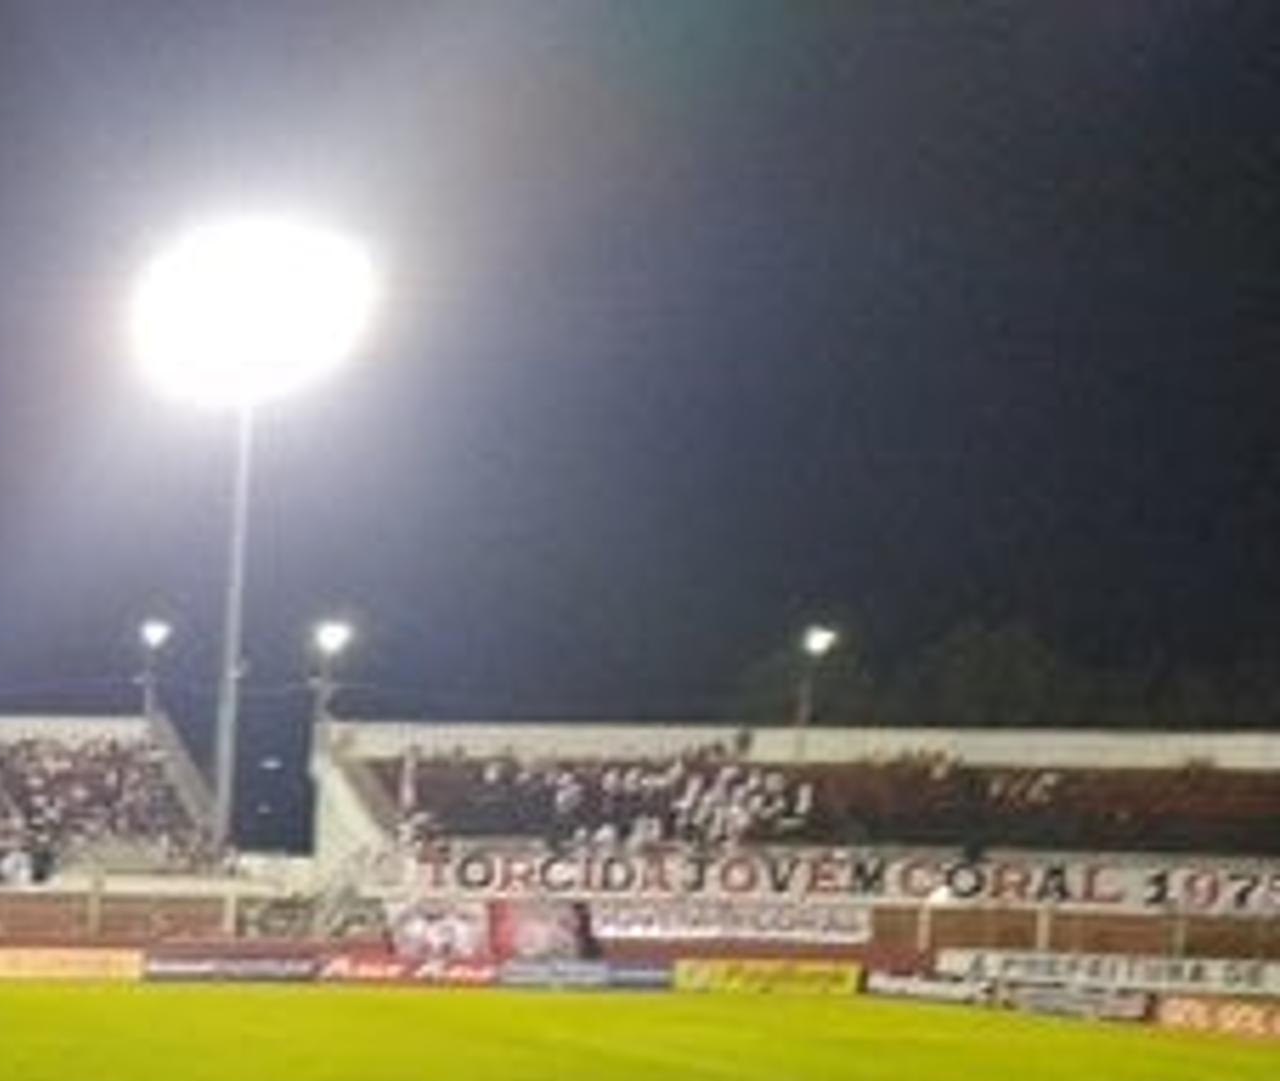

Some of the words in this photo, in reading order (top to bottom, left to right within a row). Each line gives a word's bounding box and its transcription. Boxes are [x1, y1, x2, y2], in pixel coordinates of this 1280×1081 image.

[416, 848, 672, 893] TORCIDA
[687, 854, 886, 894] JOVEM
[900, 860, 1123, 902] CORAL
